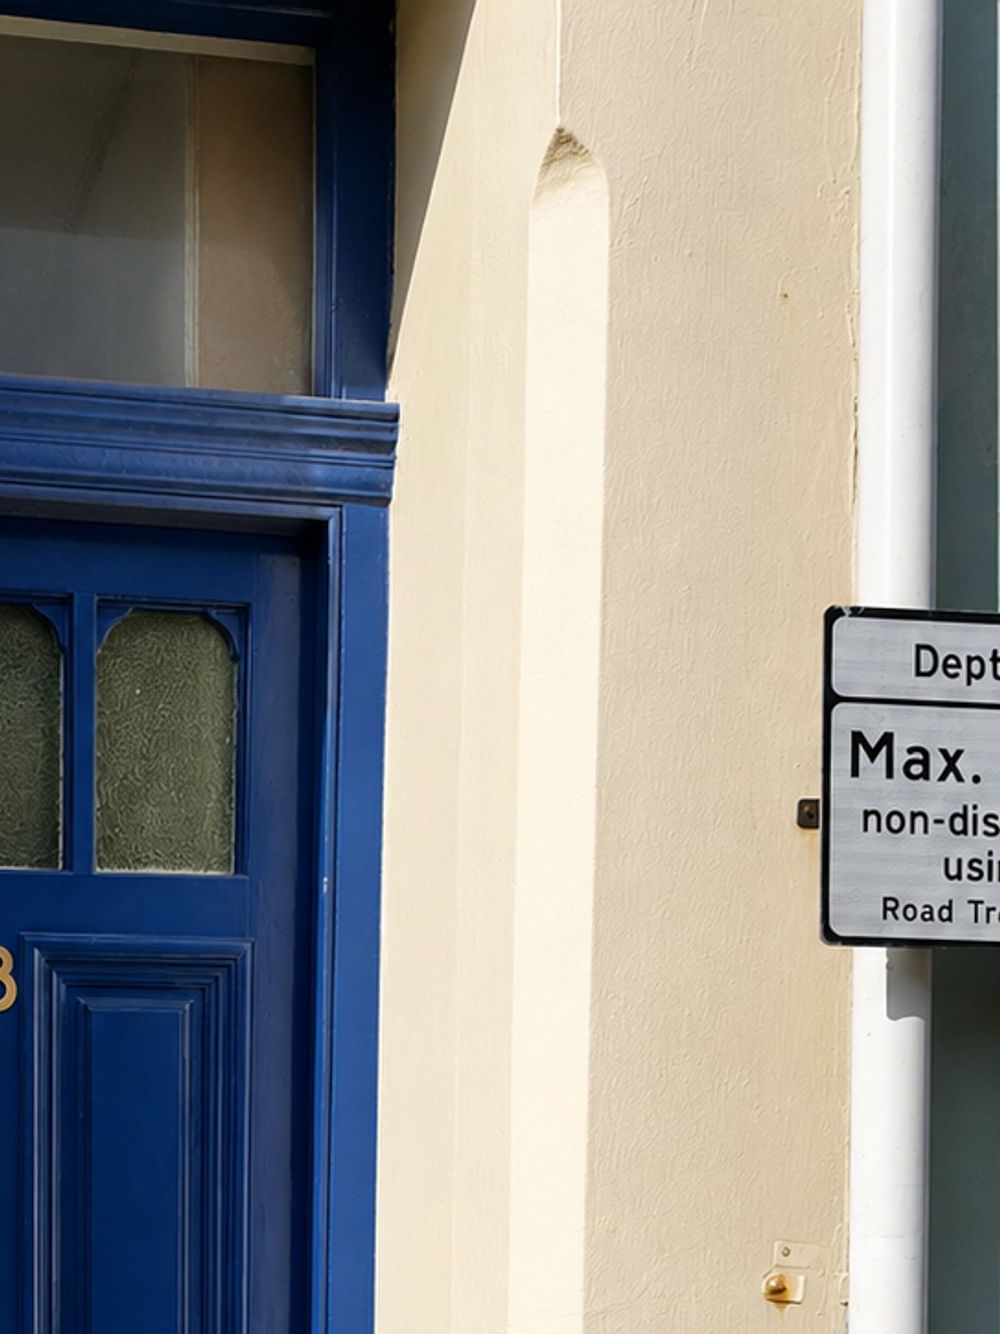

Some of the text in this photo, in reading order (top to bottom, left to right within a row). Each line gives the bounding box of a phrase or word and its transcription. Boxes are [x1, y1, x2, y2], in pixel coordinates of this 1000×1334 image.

[850, 730, 982, 785] Max.
[862, 803, 1000, 838] non-dis
[943, 849, 1000, 883] usi
[882, 896, 1000, 924] Road Tr
